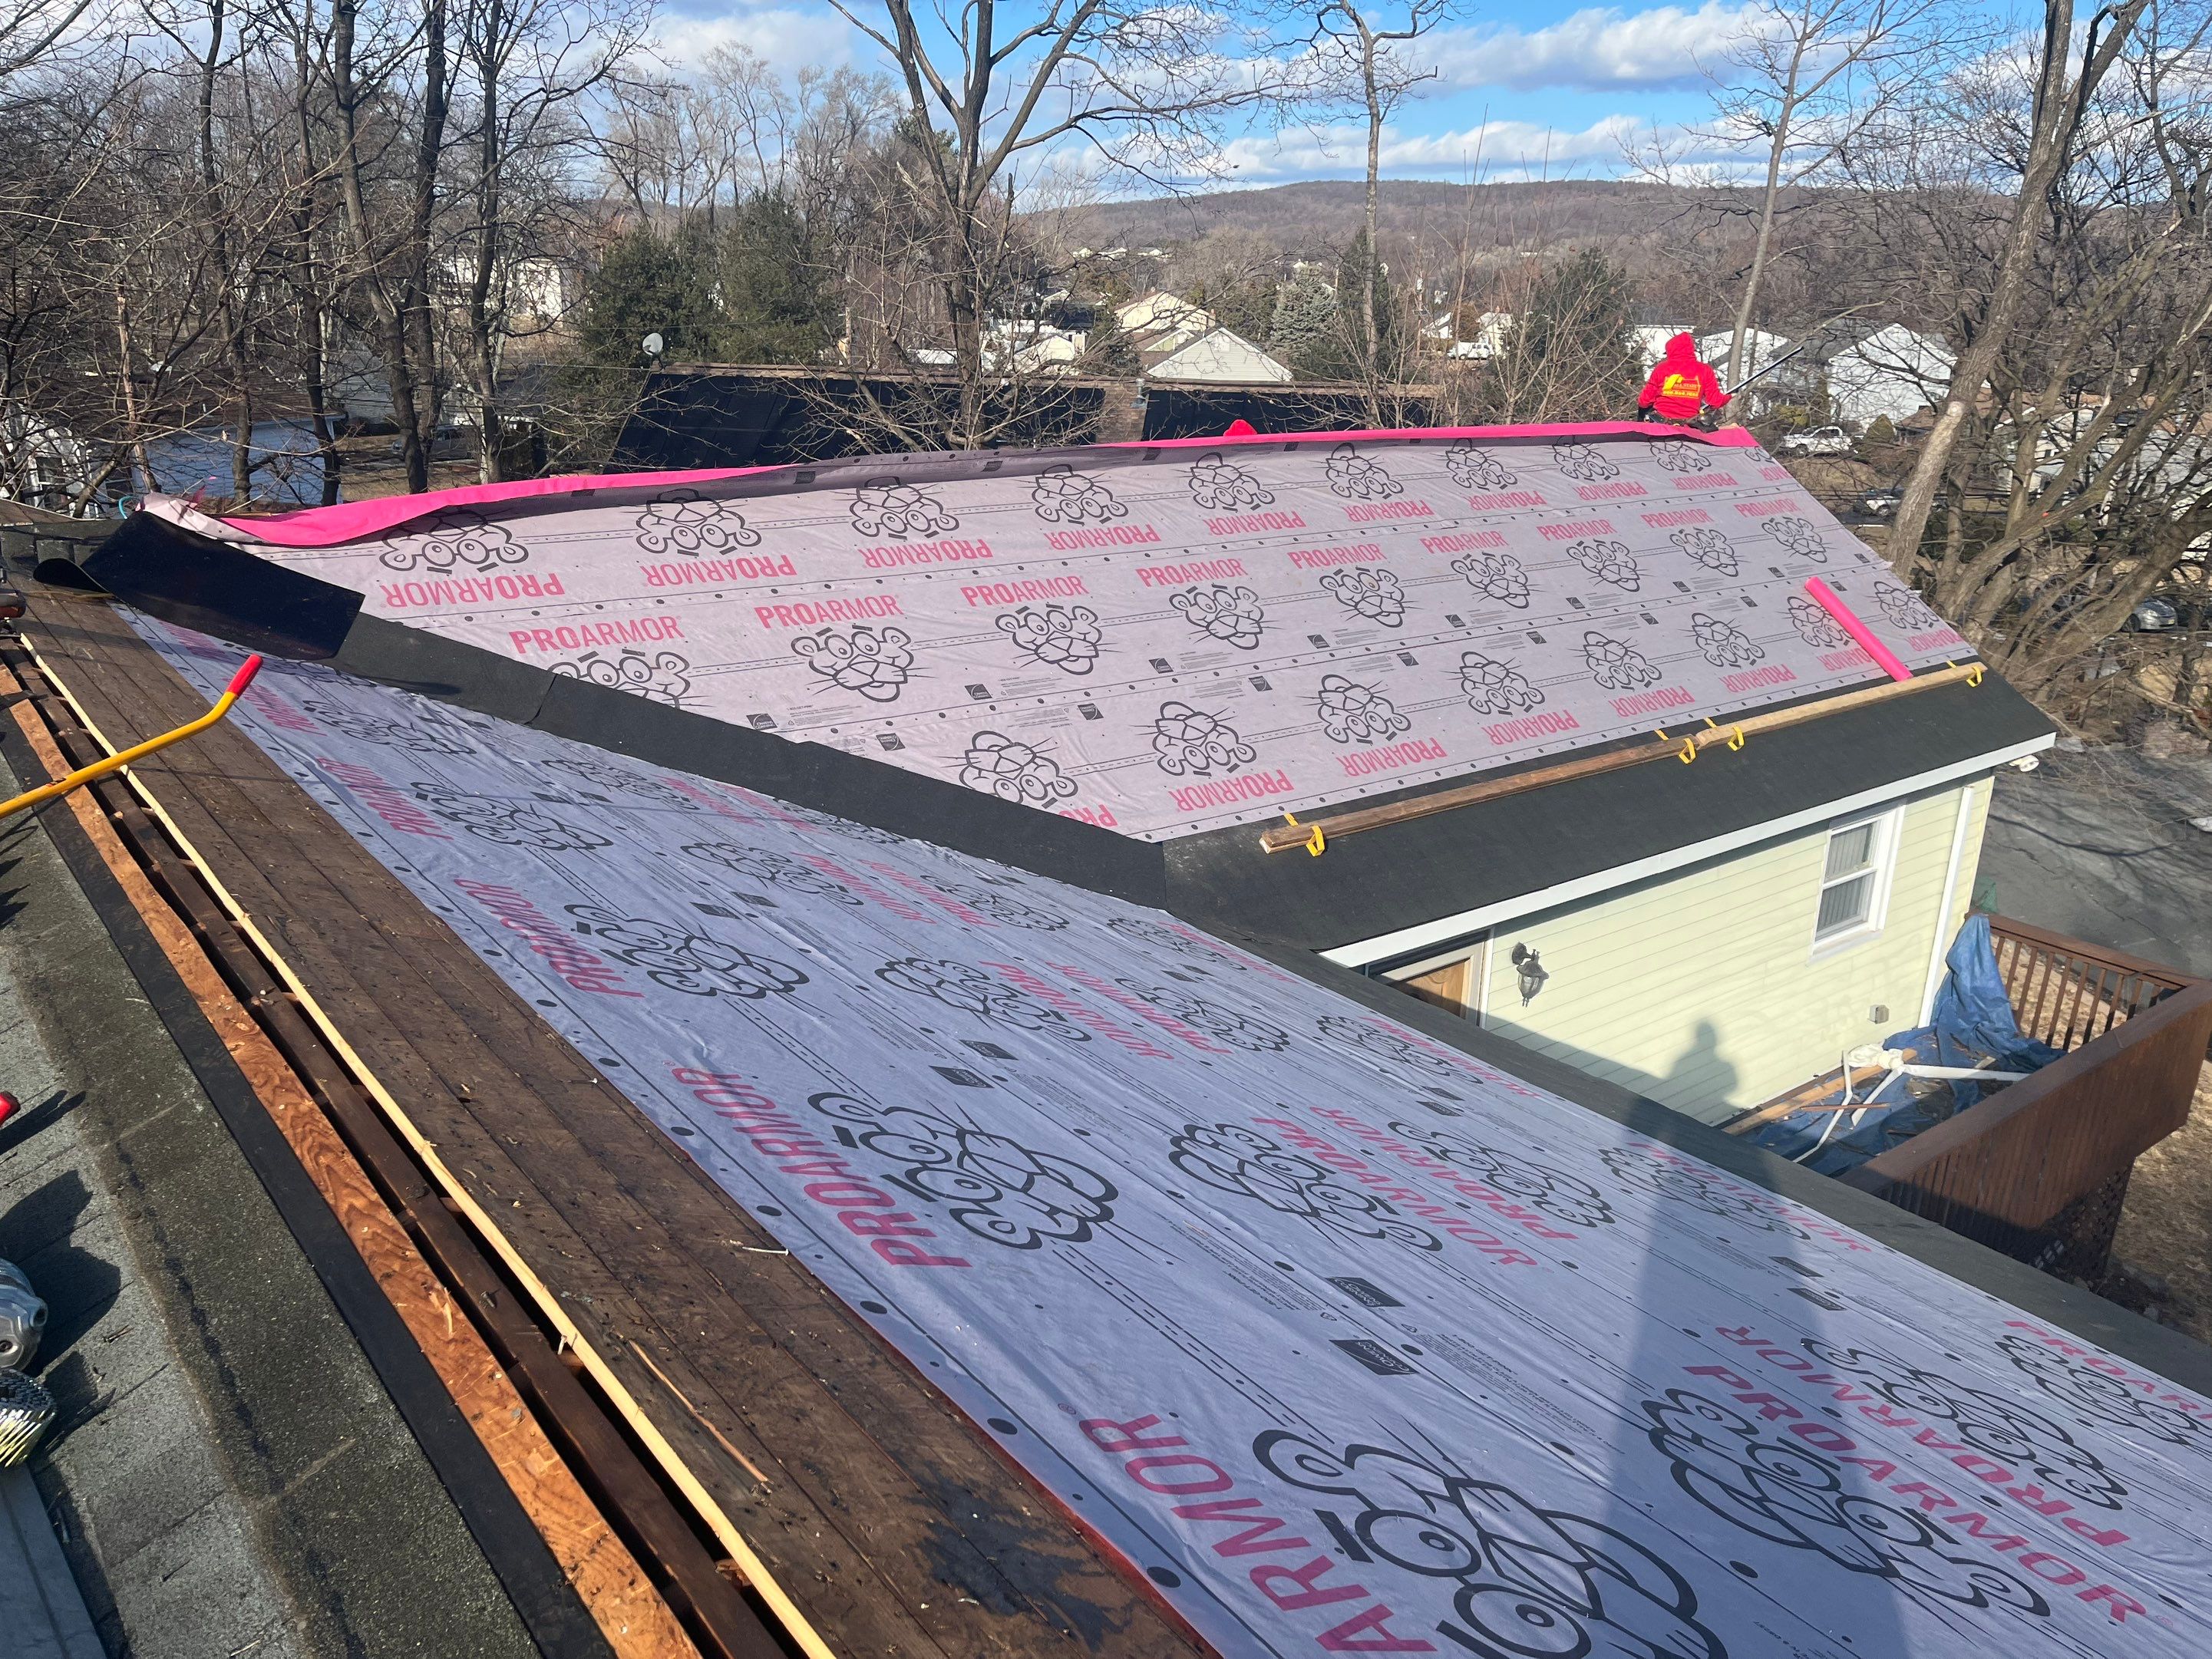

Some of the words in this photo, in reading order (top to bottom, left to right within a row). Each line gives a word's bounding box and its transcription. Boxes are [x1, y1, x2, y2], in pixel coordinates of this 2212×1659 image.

[1465, 490, 1547, 512] PROARMOR
[1573, 480, 1648, 502] PROARMOR
[1204, 510, 1306, 536] PROARMOR
[1343, 500, 1434, 523] PROARMOR
[1641, 508, 1709, 528] PROARMOR
[1044, 523, 1161, 551] PROARMOR
[1421, 530, 1508, 554] PROARMOR
[1537, 519, 1616, 542] PROARMOR
[859, 539, 993, 569] PROARMOR
[1288, 543, 1387, 569] PROARMOR
[641, 555, 797, 587] PROARMOR
[1135, 557, 1248, 587] PROARMOR
[380, 572, 565, 609] PROARMOR
[960, 575, 1088, 607] PROARMOR
[754, 593, 903, 628] PROARMOR
[509, 615, 684, 654] PROARMOR
[1724, 663, 1796, 693] PROARMOR
[1609, 685, 1695, 718] PROARMOR
[1481, 710, 1580, 746] PROARMOR
[1336, 737, 1447, 777] PROARMOR
[1169, 768, 1295, 811] PROARMOR
[1059, 804, 1118, 826] PR
[454, 877, 645, 998] PROARMOR
[979, 960, 1176, 1060] PROARMOR
[672, 1067, 972, 1268] PROARMOR
[1309, 1106, 1580, 1241] PROARMOR
[1251, 1116, 1537, 1267] PROARMOR
[1627, 1142, 1872, 1252] PROARMOR
[2002, 1321, 2211, 1419] PROAR
[1715, 1326, 2131, 1548] PROARMOR
[1682, 1366, 2148, 1623] PROARMOR
